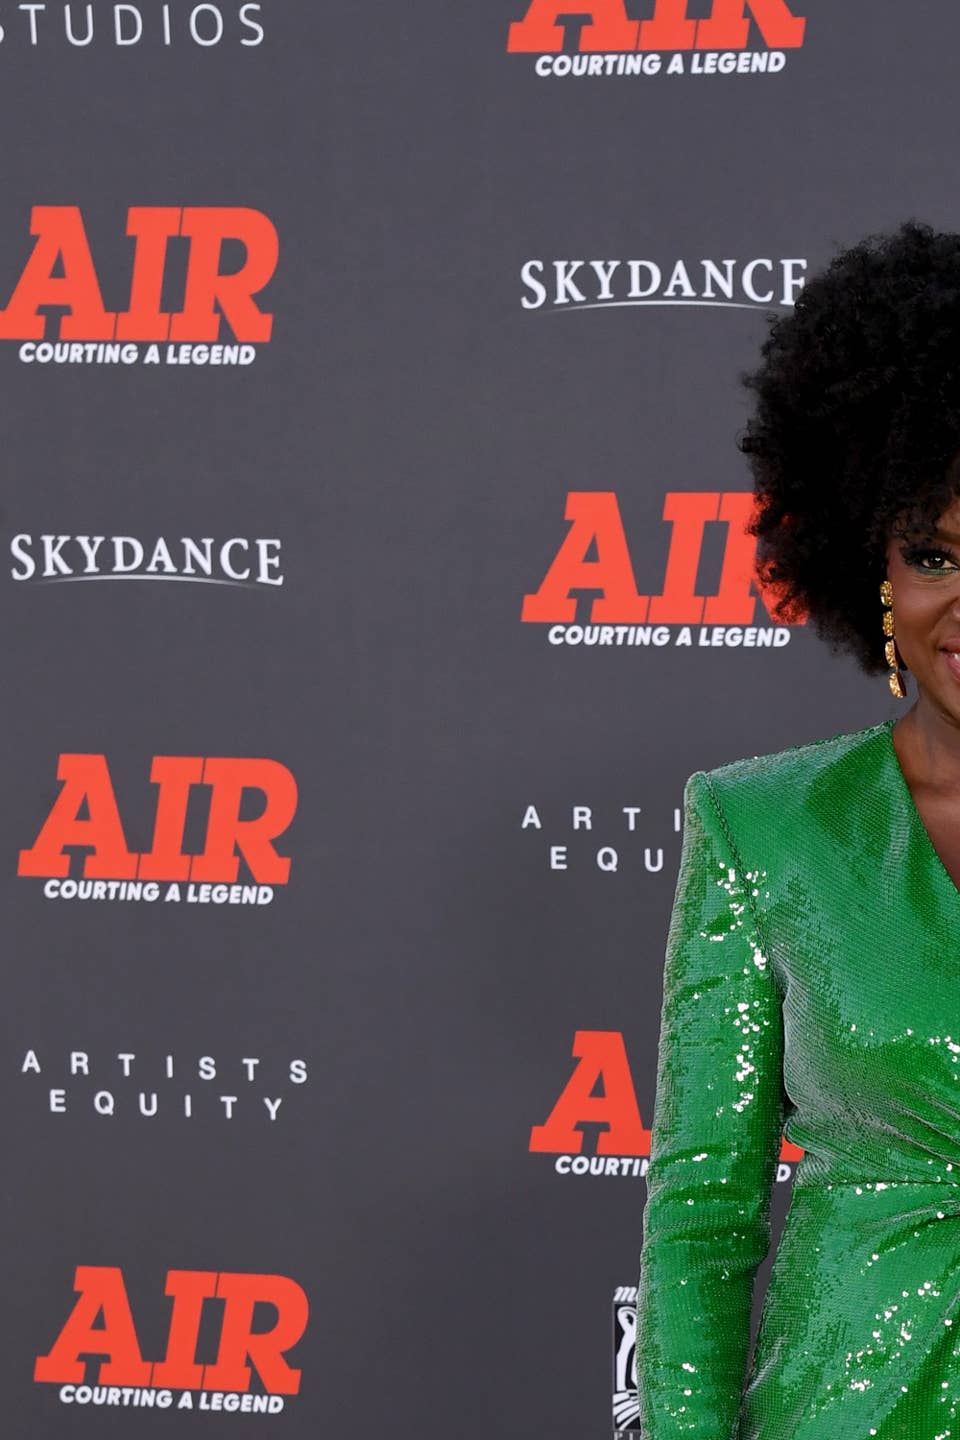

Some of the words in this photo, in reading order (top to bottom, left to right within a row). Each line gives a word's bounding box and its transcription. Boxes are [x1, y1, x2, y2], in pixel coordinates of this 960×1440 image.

[0, 3, 264, 47] TUDIOS
[534, 53, 661, 77] COURTING
[666, 53, 685, 75] A
[690, 51, 786, 74] LEGEND
[0, 205, 280, 343] AIR
[18, 342, 139, 365] COURTING
[143, 343, 161, 365] A
[165, 344, 256, 366] LEGEND
[10, 533, 284, 586] SKYDANCE
[547, 624, 671, 647] COURTING
[674, 626, 693, 647] A
[698, 626, 791, 648] LEGEND
[17, 752, 298, 885] AIR
[43, 879, 160, 902] COURTING
[164, 883, 181, 903] A
[186, 883, 274, 905] LEGEND
[21, 1049, 308, 1084] ARTISTS
[49, 1088, 282, 1121] EQUITY
[33, 1265, 309, 1395] AIR
[59, 1384, 173, 1409] COURTING
[177, 1390, 193, 1410] A
[199, 1391, 284, 1414] LEGEND
